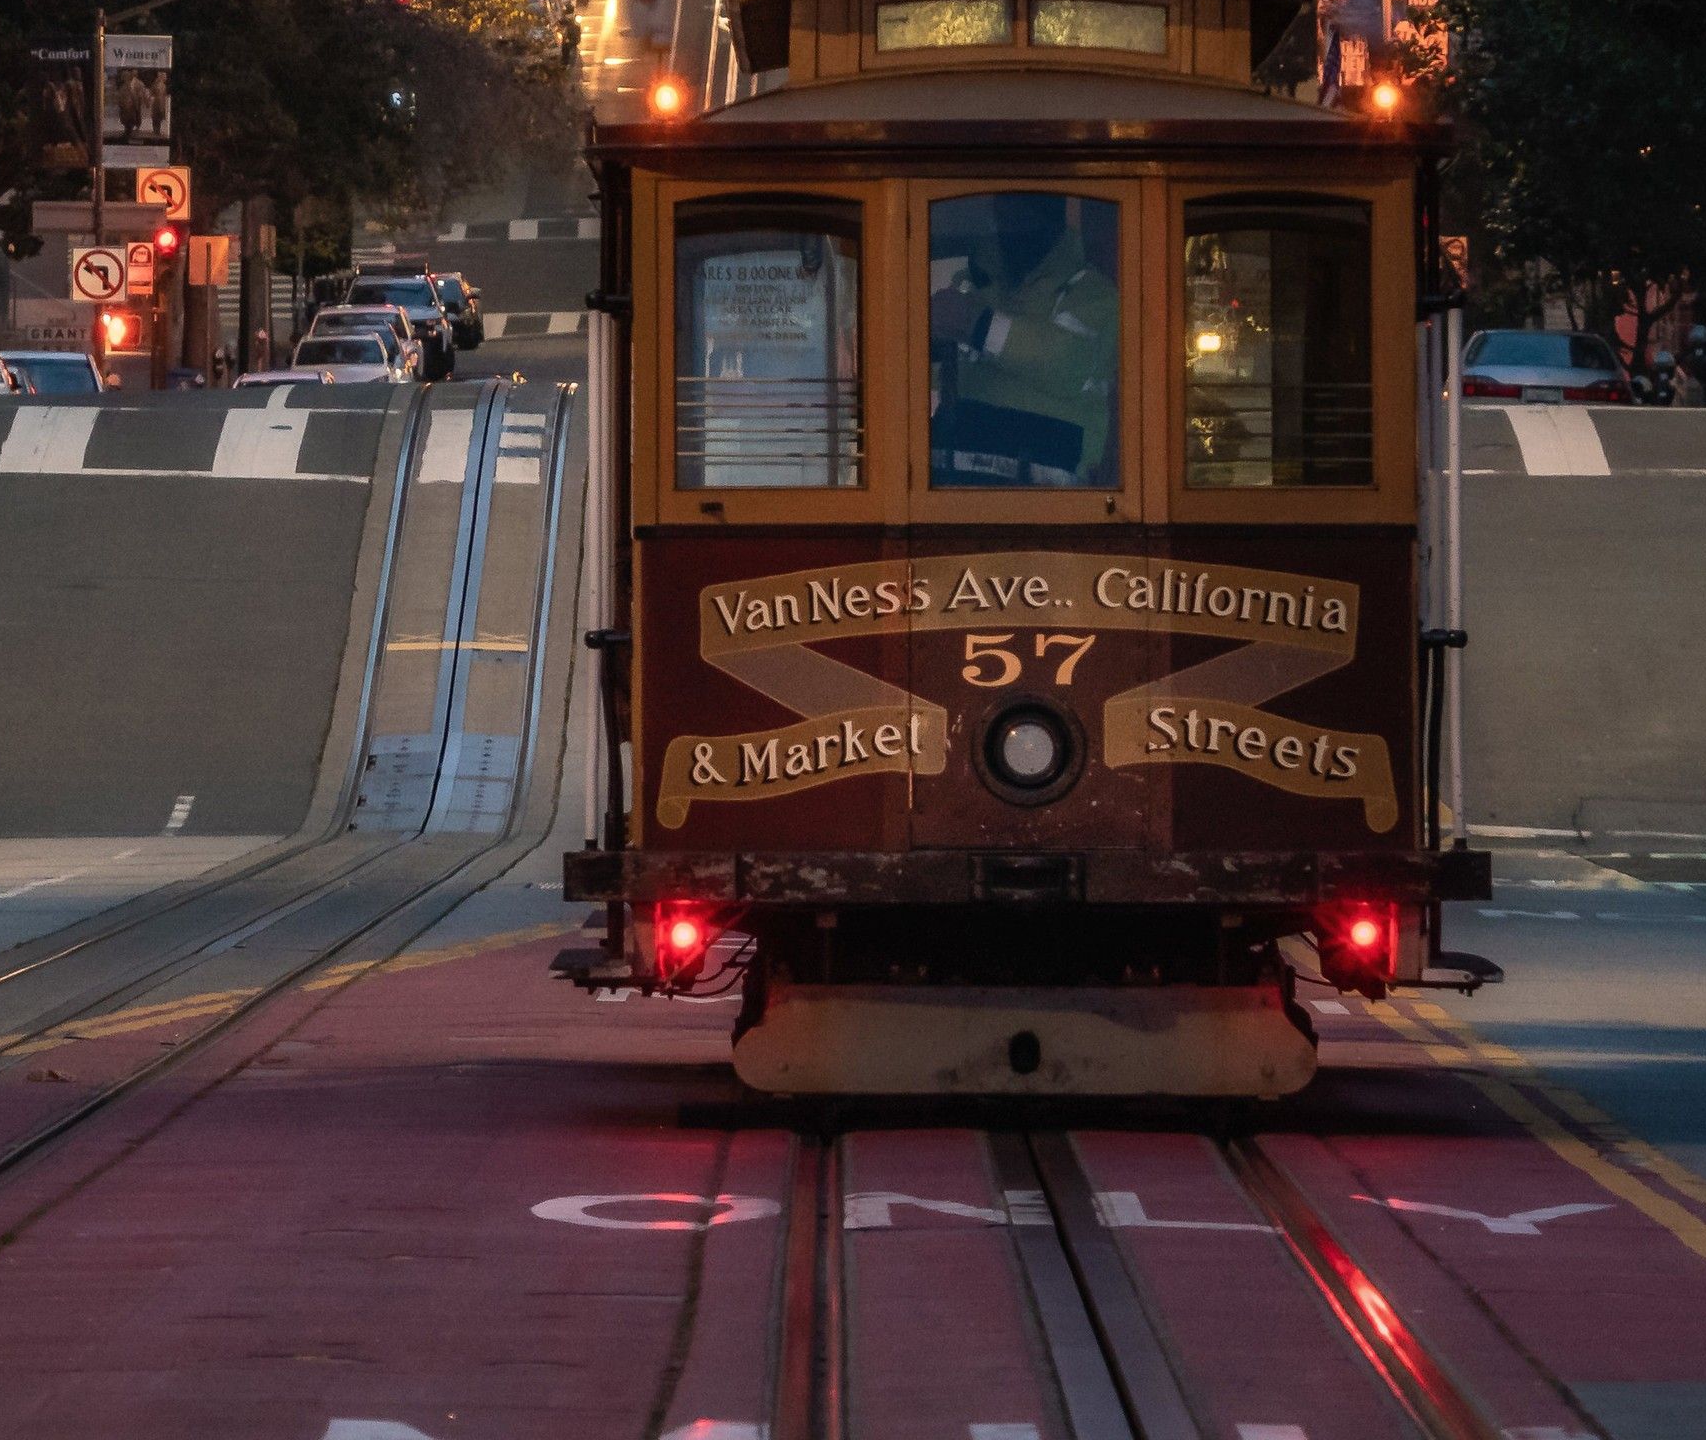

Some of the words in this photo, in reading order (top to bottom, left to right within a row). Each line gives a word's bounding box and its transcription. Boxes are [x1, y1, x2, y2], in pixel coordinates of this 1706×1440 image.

[30, 328, 88, 339] GRANT
[714, 590, 801, 634] Van
[811, 571, 931, 626] Ness
[1096, 568, 1349, 633] California
[961, 633, 1096, 687] 57
[692, 742, 726, 785] &
[742, 712, 925, 783] Market
[1145, 707, 1363, 779] Streets
[531, 1190, 1617, 1236] ONLY
